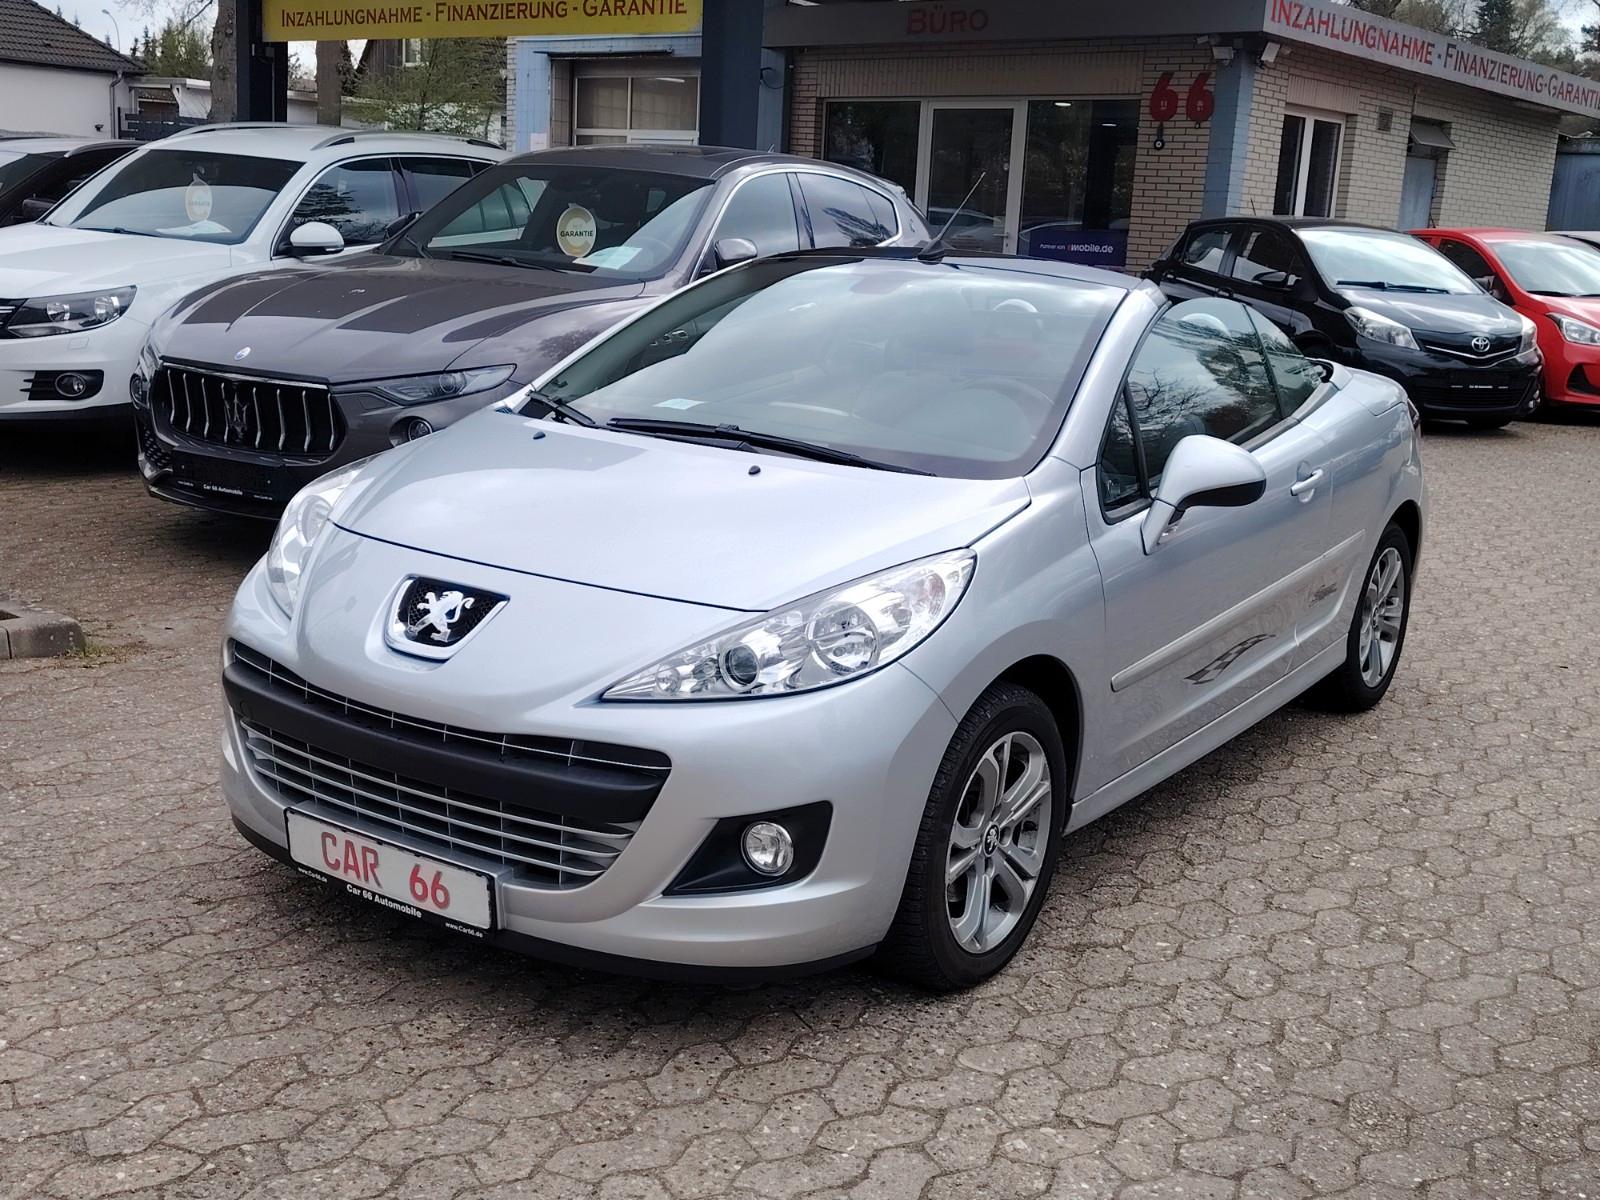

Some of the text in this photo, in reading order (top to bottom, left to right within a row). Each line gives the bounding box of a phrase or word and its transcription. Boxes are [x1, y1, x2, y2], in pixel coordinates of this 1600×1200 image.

[281, 8, 423, 27] INZAHLUNGNAHME
[435, 2, 568, 22] FINANZIERUNG
[582, 0, 688, 17] GARANTIE
[906, 3, 989, 33] BÜRO
[1270, 0, 1435, 66] INZAHLUNGNAHME
[1150, 71, 1215, 121] 66
[321, 832, 451, 910] CAR 66
[346, 884, 422, 918] Car 66 Automobile
